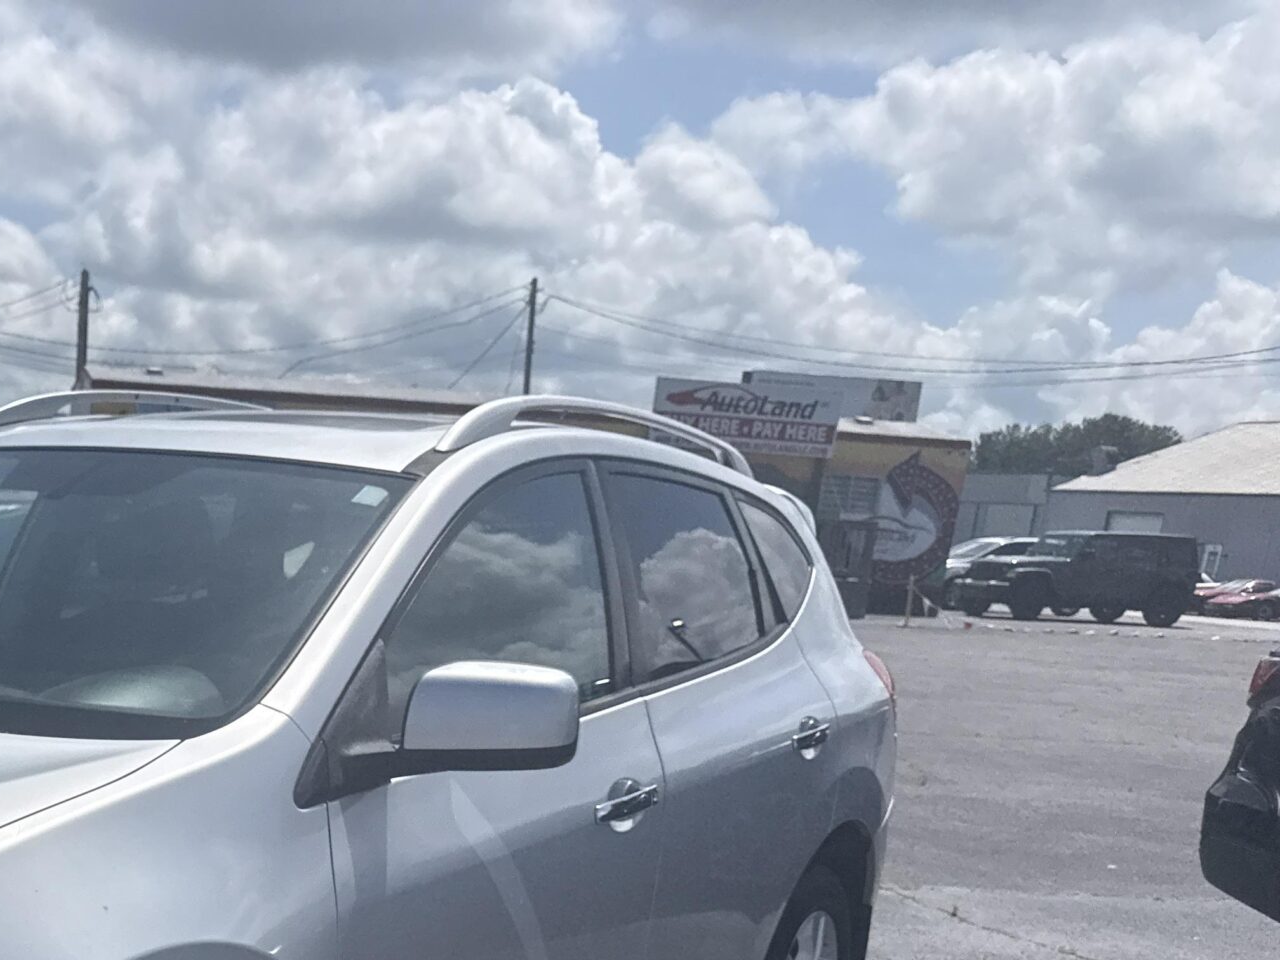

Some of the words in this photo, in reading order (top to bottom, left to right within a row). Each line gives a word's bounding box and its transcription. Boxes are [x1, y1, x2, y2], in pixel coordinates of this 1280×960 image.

[700, 391, 819, 420] AutoLand
[699, 416, 740, 435] HERE
[751, 420, 783, 440] PAY
[785, 423, 828, 442] HERE
